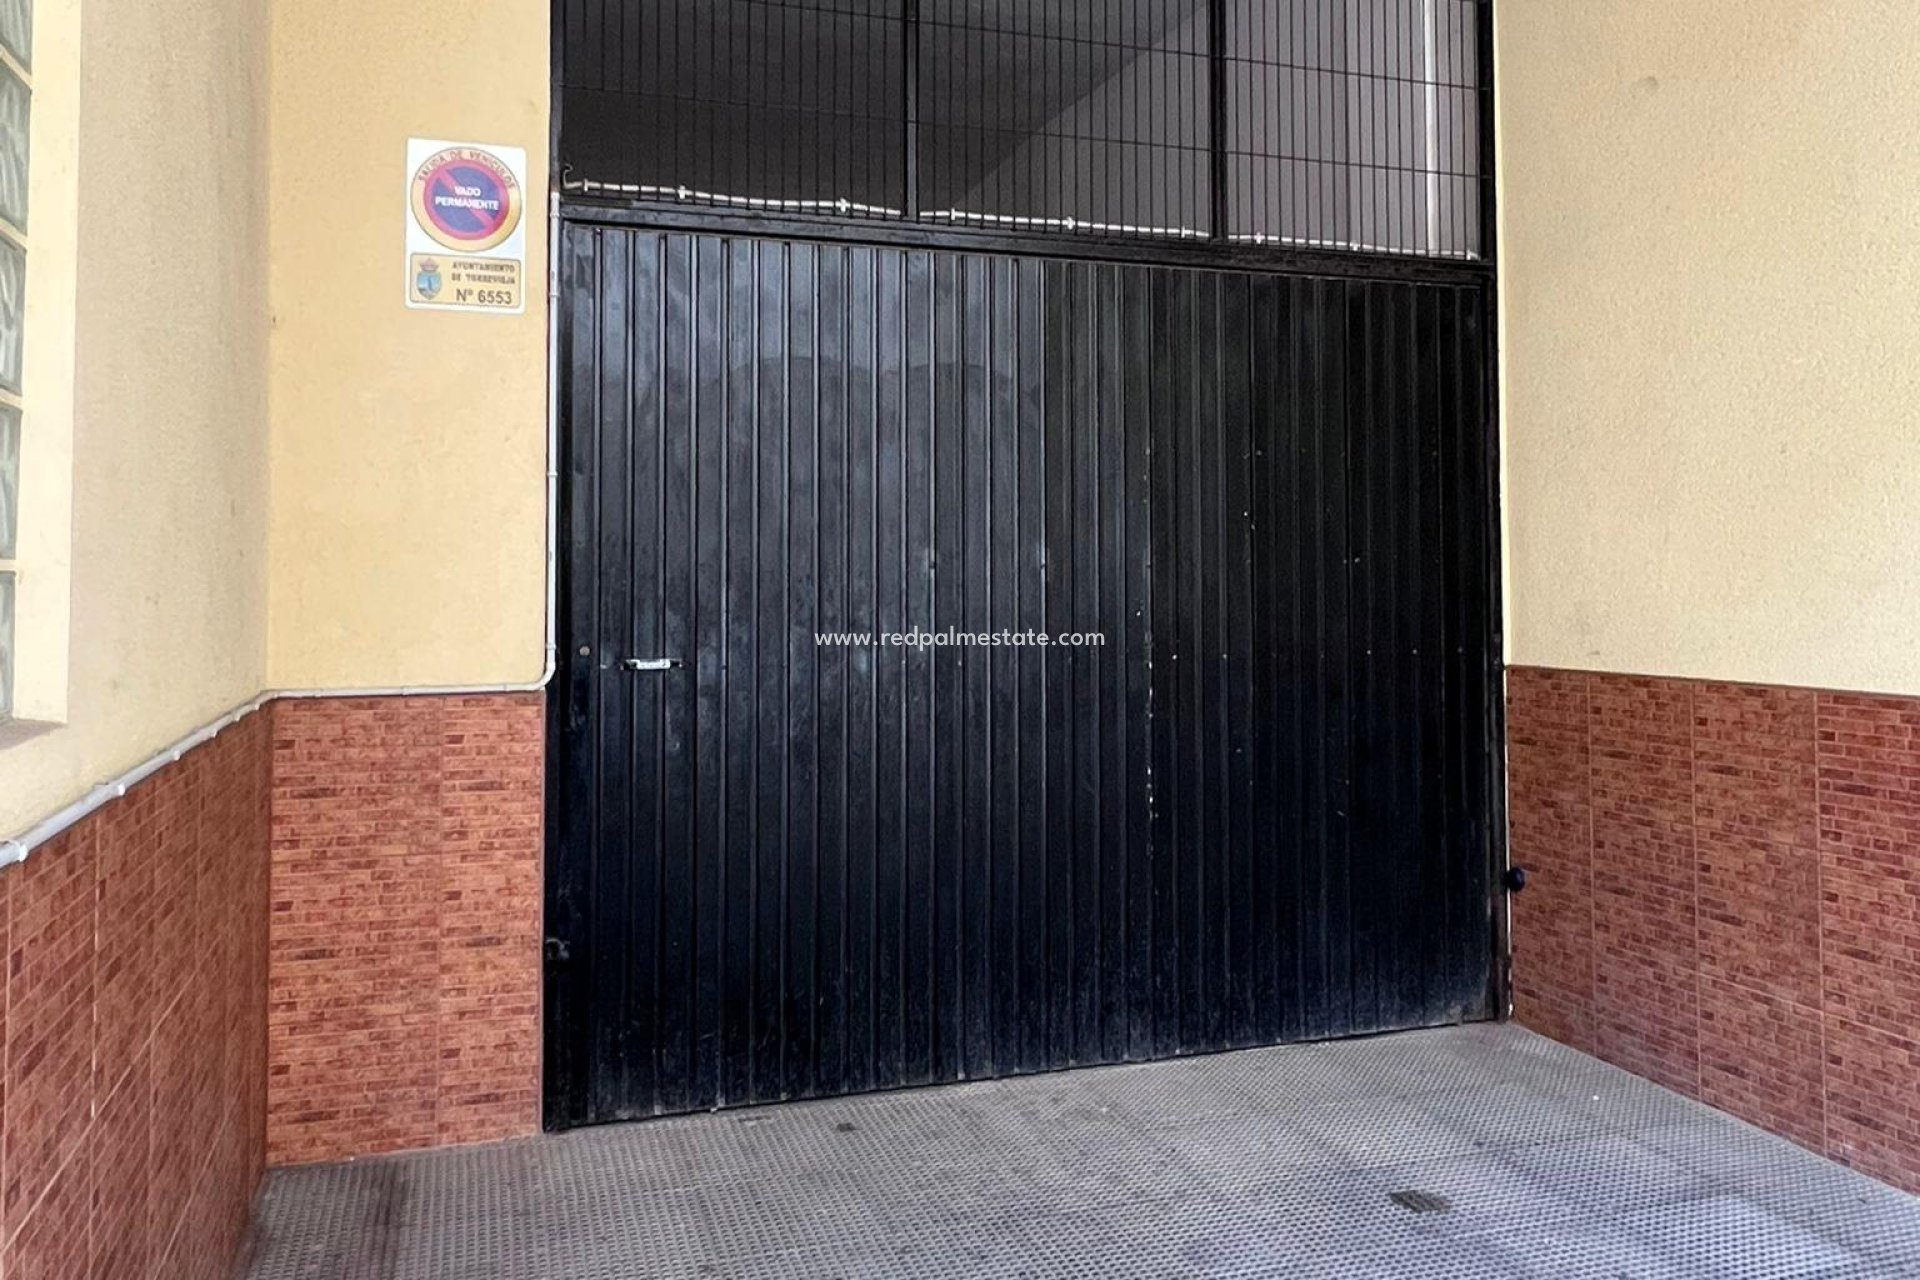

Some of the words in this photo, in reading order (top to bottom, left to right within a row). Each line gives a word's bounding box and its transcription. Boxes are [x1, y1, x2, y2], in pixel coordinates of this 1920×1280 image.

[454, 186, 481, 197] VADO
[435, 196, 500, 211] PERMANENTE
[452, 262, 515, 273] AYUNTAMIENTO
[451, 273, 461, 281] DE
[465, 273, 516, 284] TORREVIEJA
[478, 289, 512, 305] 6553
